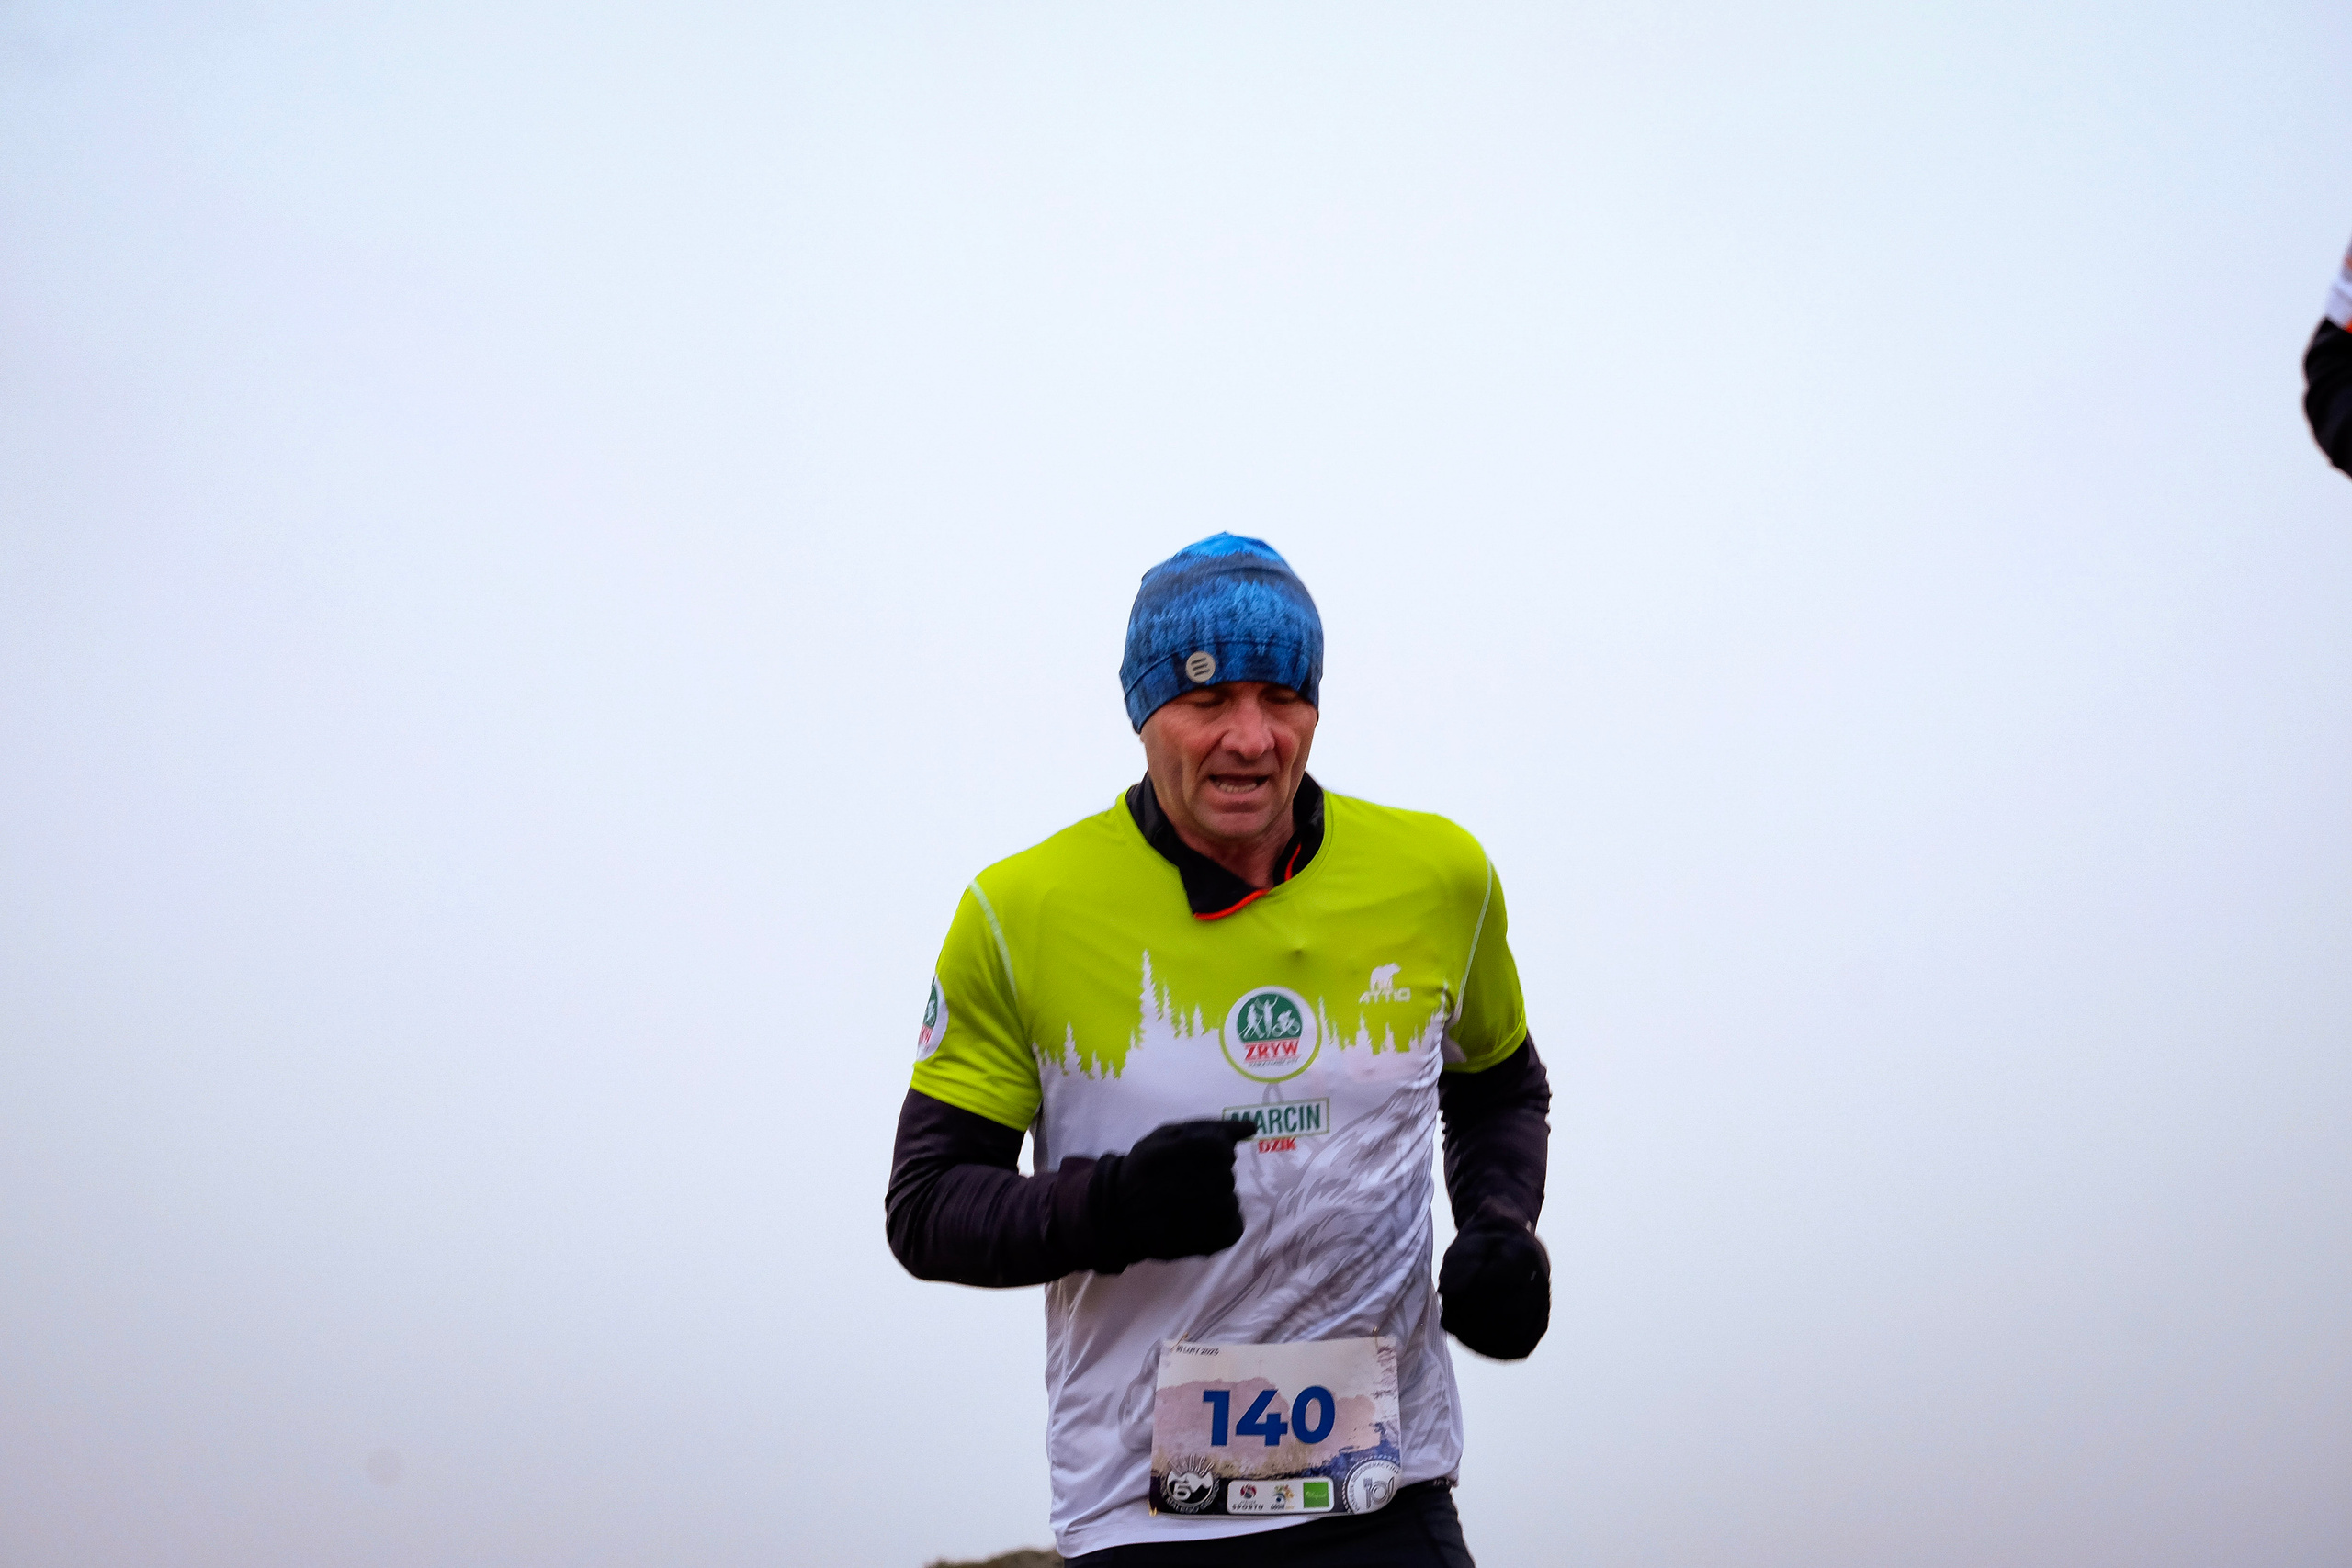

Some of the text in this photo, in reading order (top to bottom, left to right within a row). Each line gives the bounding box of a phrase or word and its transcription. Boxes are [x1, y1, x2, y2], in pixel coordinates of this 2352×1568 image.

[1244, 1038, 1300, 1063] ZRYW
[1258, 1136, 1297, 1154] DZIK
[1203, 1385, 1335, 1447] 140
